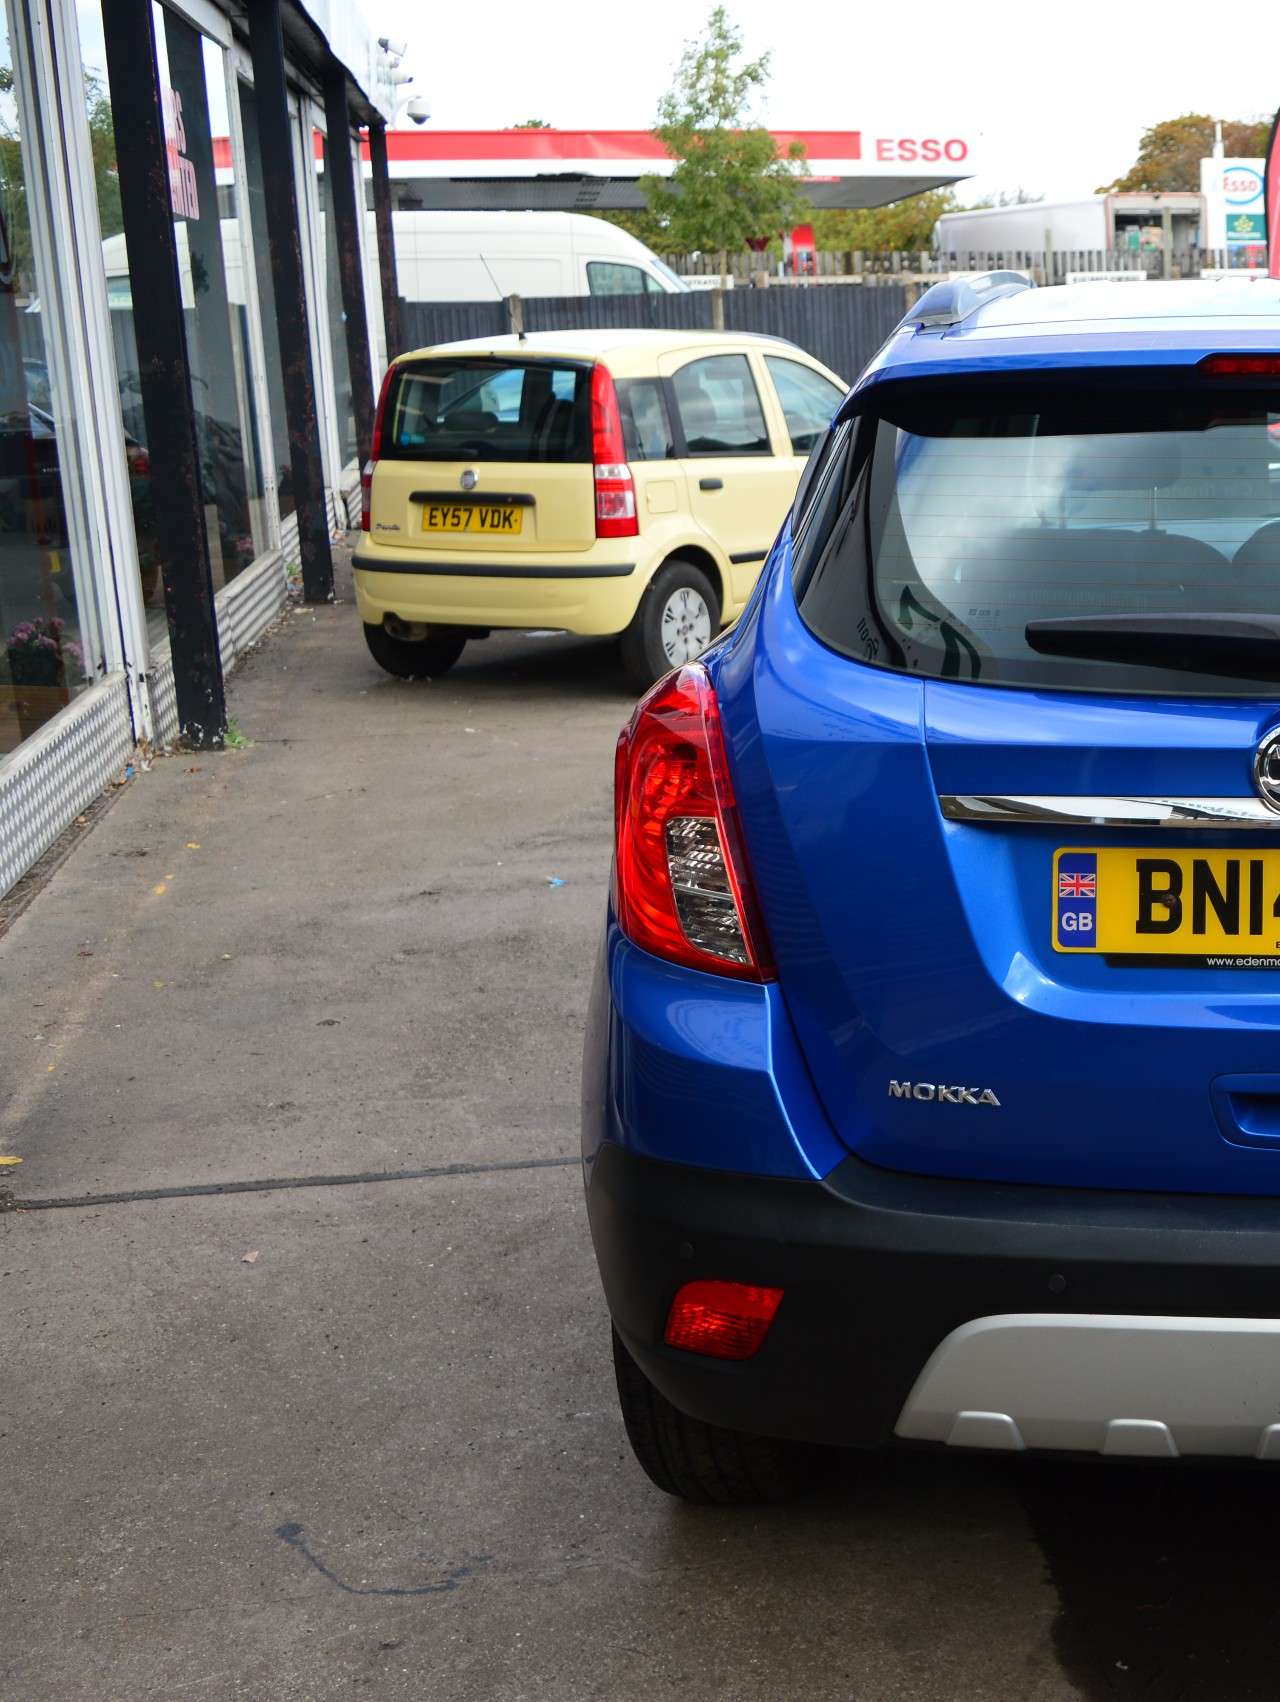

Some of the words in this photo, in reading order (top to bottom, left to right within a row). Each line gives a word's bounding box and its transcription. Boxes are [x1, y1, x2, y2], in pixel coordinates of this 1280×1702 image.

[876, 138, 968, 162] ESSO
[428, 507, 473, 527] EY57
[479, 508, 515, 529] VDK
[1061, 912, 1093, 932] GB
[888, 1079, 1001, 1106] MOKKA
